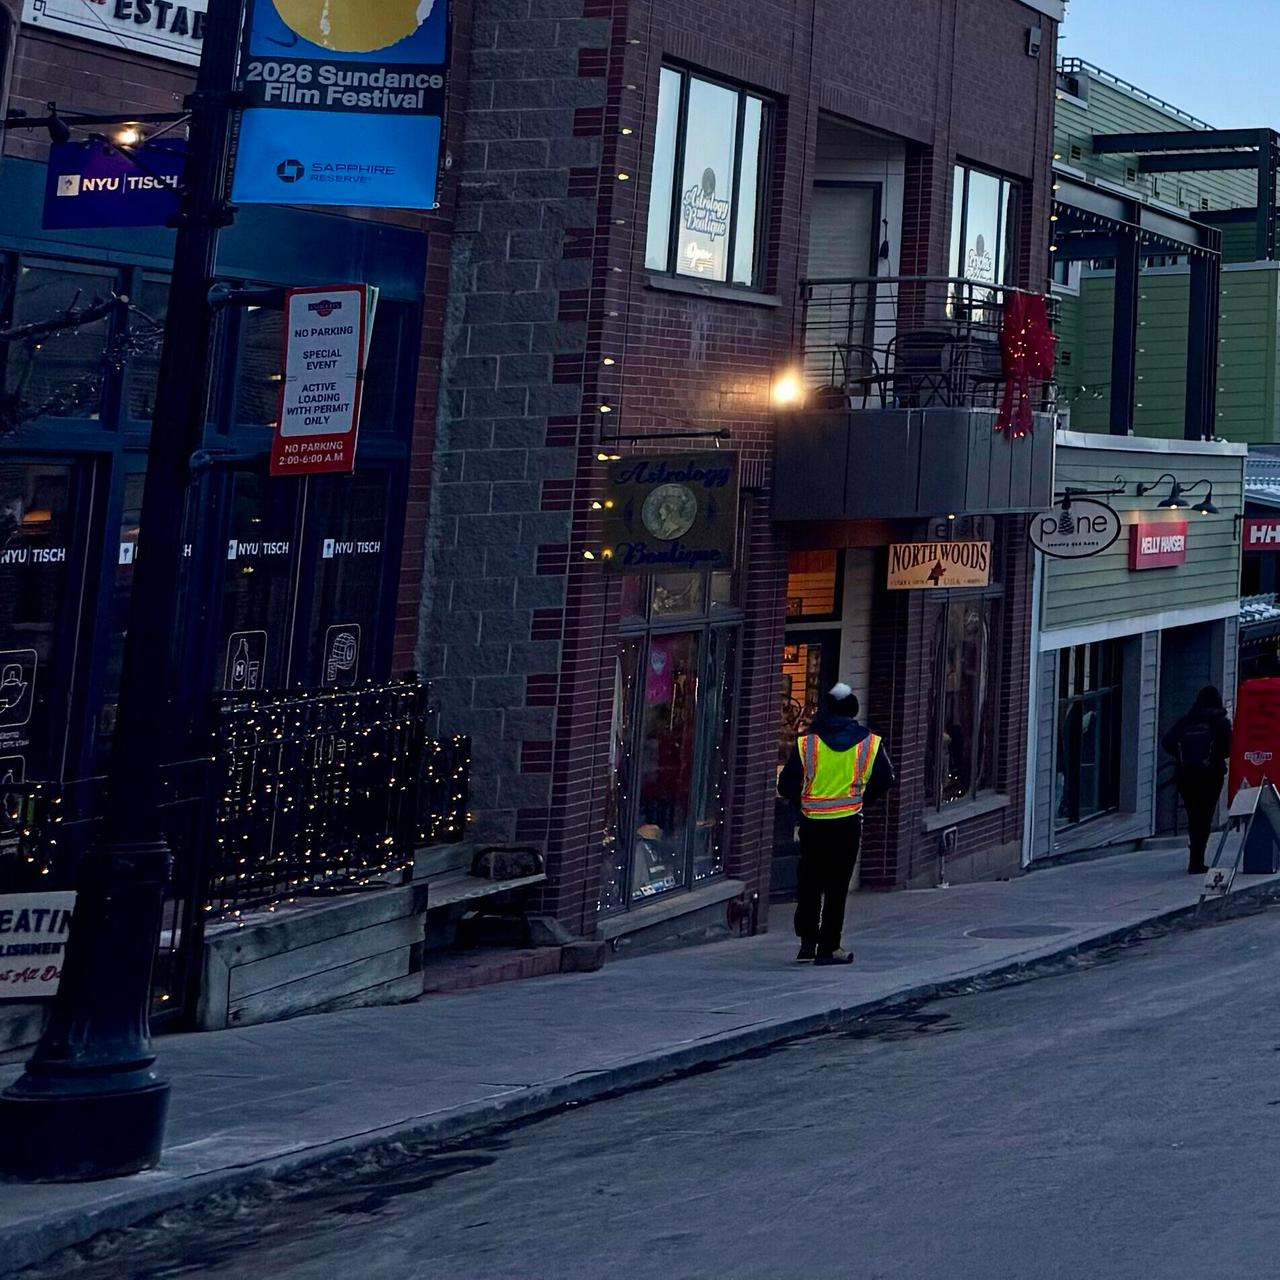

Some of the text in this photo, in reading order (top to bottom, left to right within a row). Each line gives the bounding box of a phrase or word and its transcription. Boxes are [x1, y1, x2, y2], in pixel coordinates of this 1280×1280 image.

[247, 62, 443, 88] 2026 Sundance
[264, 83, 424, 108] Film Festival
[312, 163, 396, 175] SAPPHIRE
[82, 176, 178, 191] NYU TISCH
[294, 326, 353, 338] NO PARKING
[303, 349, 342, 359] SPECIAL
[306, 360, 338, 370] EVENT
[302, 382, 336, 392] ACTIVE
[298, 393, 340, 404] LOADING
[287, 403, 350, 415] WITH PERMIT
[304, 416, 330, 426] ONLY
[285, 441, 343, 453] NO PARKING
[278, 455, 322, 465] 2:00-6:00
[614, 461, 731, 488] Astrology
[238, 542, 289, 555] NYU TISCH
[335, 542, 381, 553] NYU TISCH
[1141, 535, 1185, 554] HELLY HANSEN
[32, 548, 66, 562] TISCH
[891, 543, 988, 574] NORTH WOODS
